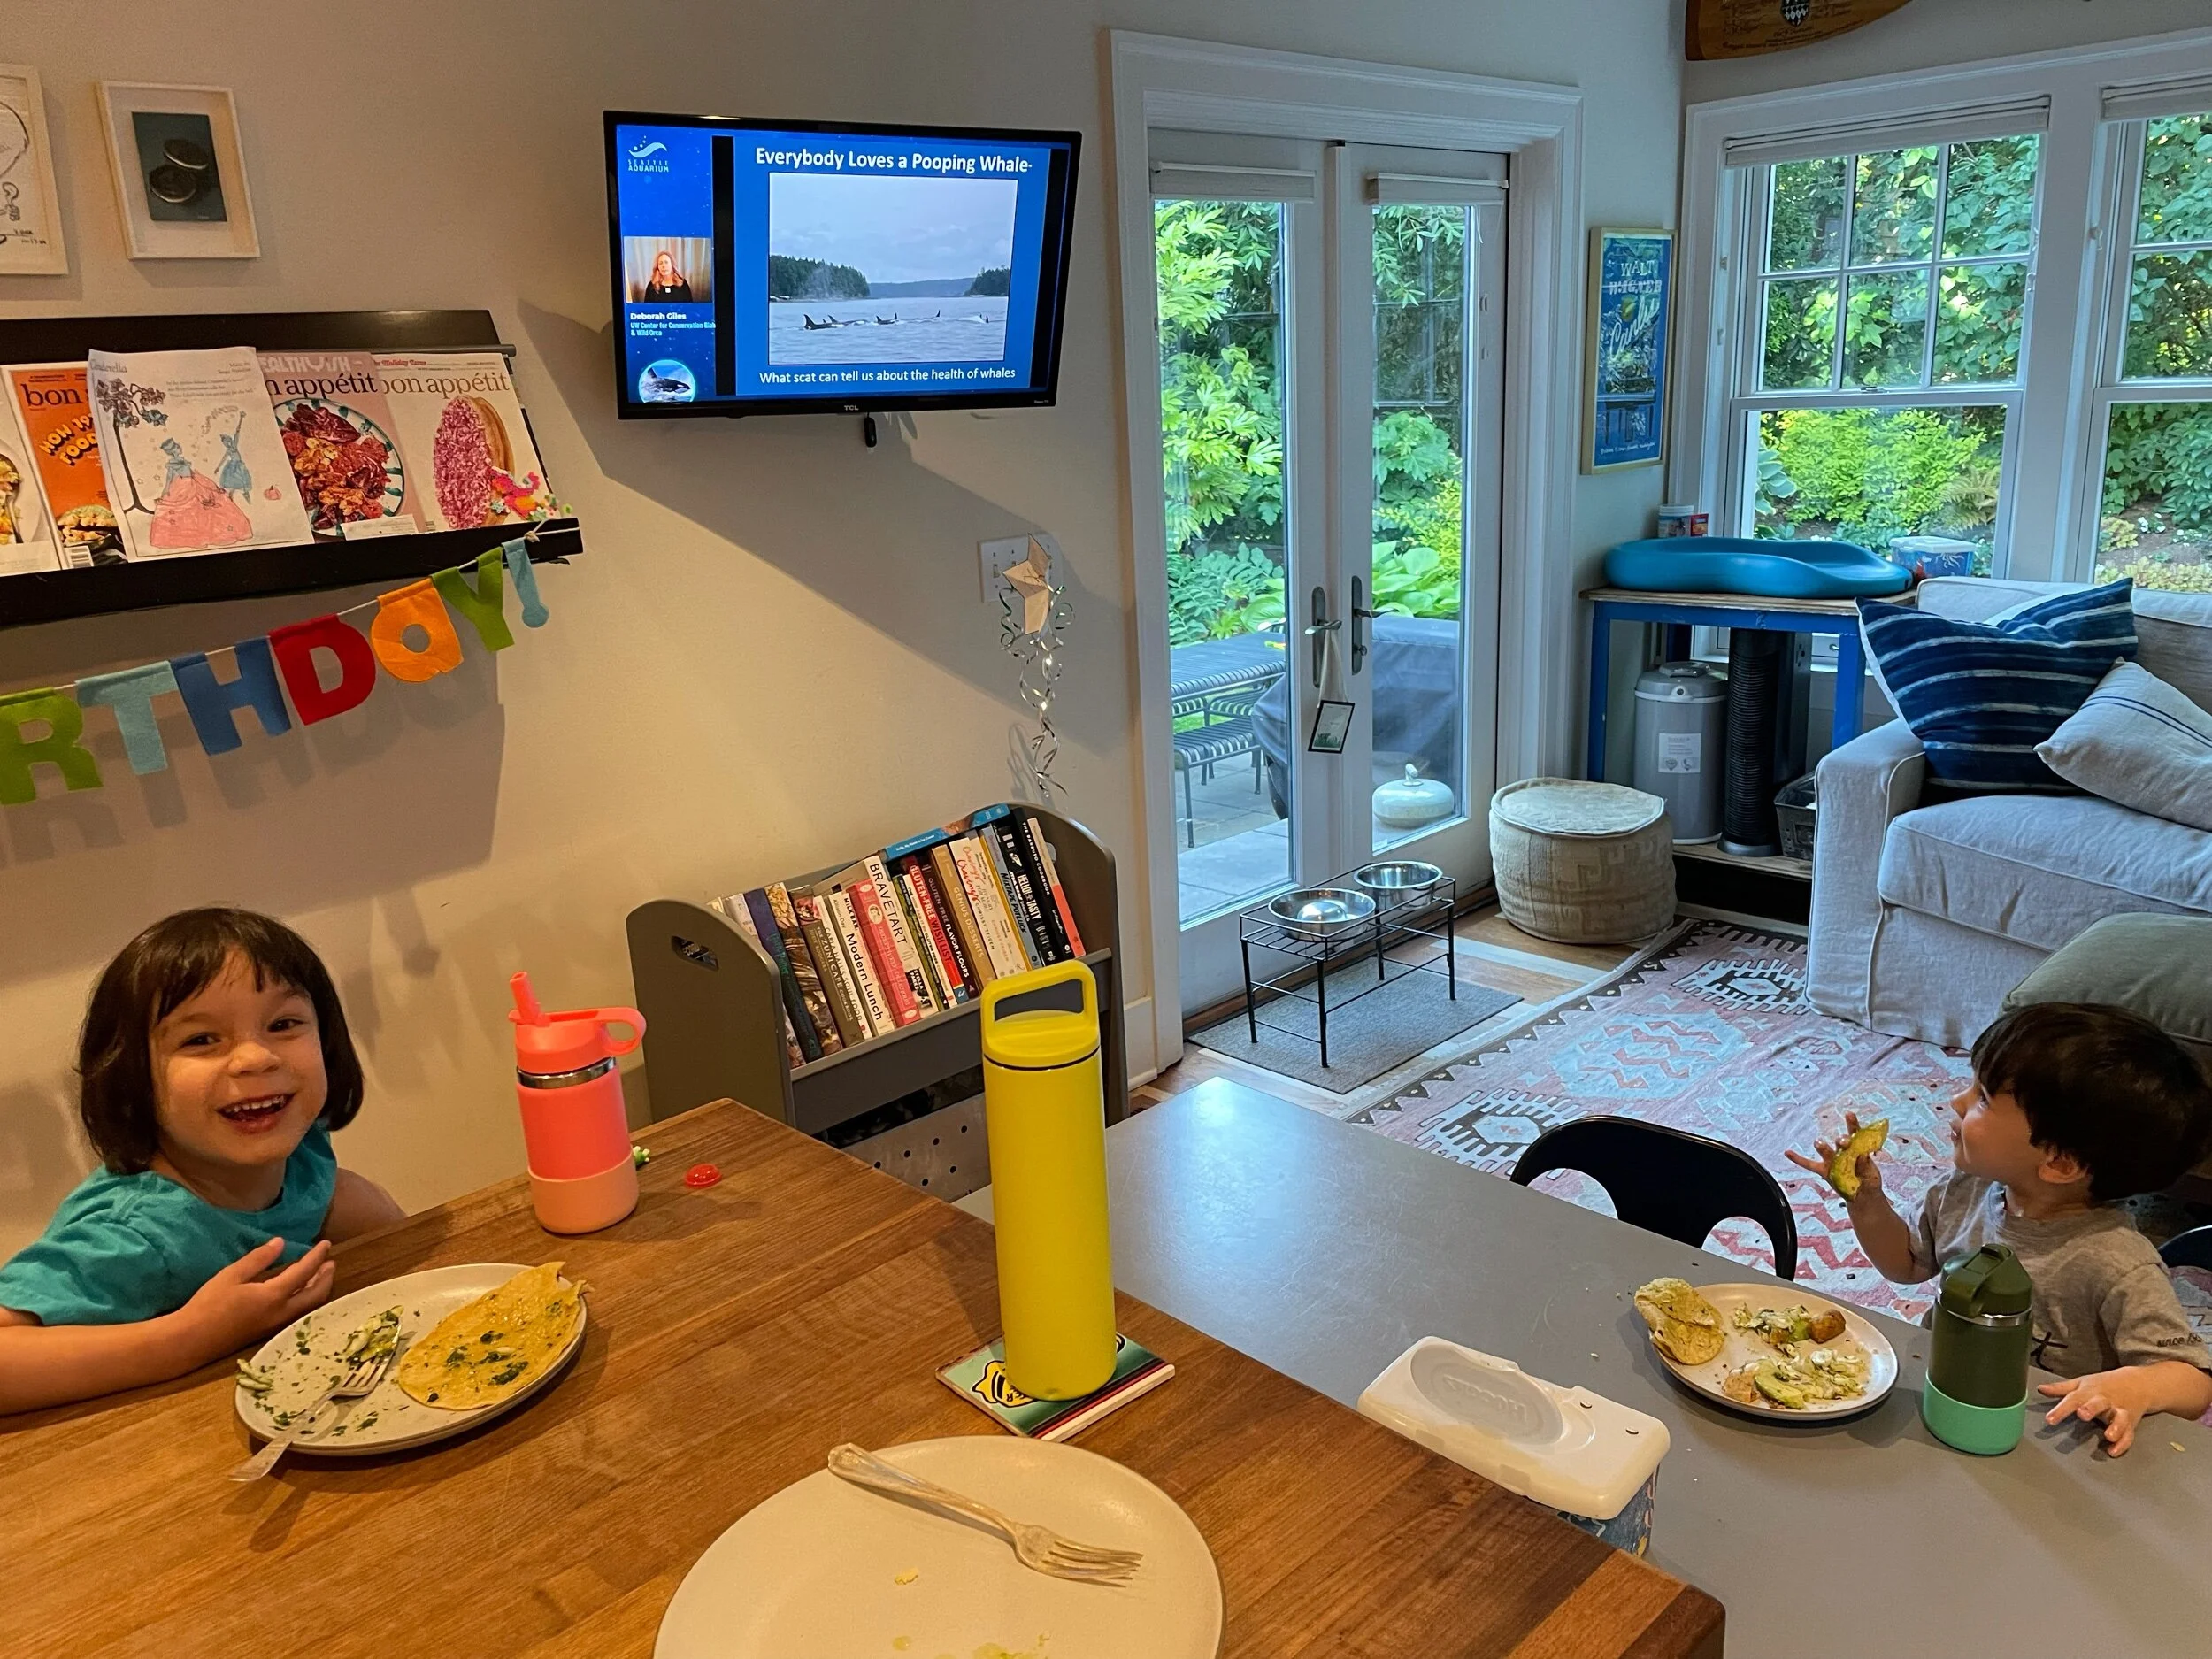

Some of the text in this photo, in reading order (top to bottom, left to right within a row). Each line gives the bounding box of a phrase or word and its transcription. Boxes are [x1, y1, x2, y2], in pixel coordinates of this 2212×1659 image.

[755, 148, 844, 170] Everybody
[849, 151, 894, 168] Loves
[897, 157, 907, 169] a
[912, 153, 976, 173] Pooping
[1620, 260, 1655, 277] WALT
[283, 371, 378, 399] appétit
[427, 372, 511, 398] appétit
[759, 373, 791, 384] What
[794, 373, 817, 383] scat
[818, 373, 839, 382] can
[841, 371, 859, 381] tell
[876, 371, 909, 381] about
[910, 369, 929, 380] the
[931, 368, 964, 380] health
[966, 367, 979, 379] of
[979, 367, 1016, 379] whales
[20, 383, 84, 407] bon
[39, 424, 74, 455] HOW
[954, 857, 982, 906] Cravings
[1035, 862, 1050, 895] COOKBOOK
[842, 897, 853, 914] MILK
[868, 862, 908, 946] BRAVETART
[909, 864, 935, 920] GLUTEN-FREE
[930, 919, 945, 943] WISH
[939, 943, 952, 963] LIST
[1000, 871, 1016, 902] MIXTAPE
[1010, 902, 1027, 933] POTLUCK
[1017, 873, 1033, 895] HELLO!
[1025, 898, 1041, 921] TASTY
[927, 877, 969, 978] GLUTEN-FREE FLAVOR FLOURS
[952, 886, 985, 958] GENIUS DESSERTS
[974, 902, 995, 949] CHRISSY TEIGEN
[819, 938, 834, 963] ZUNI
[837, 988, 854, 1021] COOKBOOK
[843, 932, 872, 981] Modern
[862, 982, 886, 1020] Lunch
[909, 972, 919, 990] PARKS
[913, 969, 924, 989] STELLA
